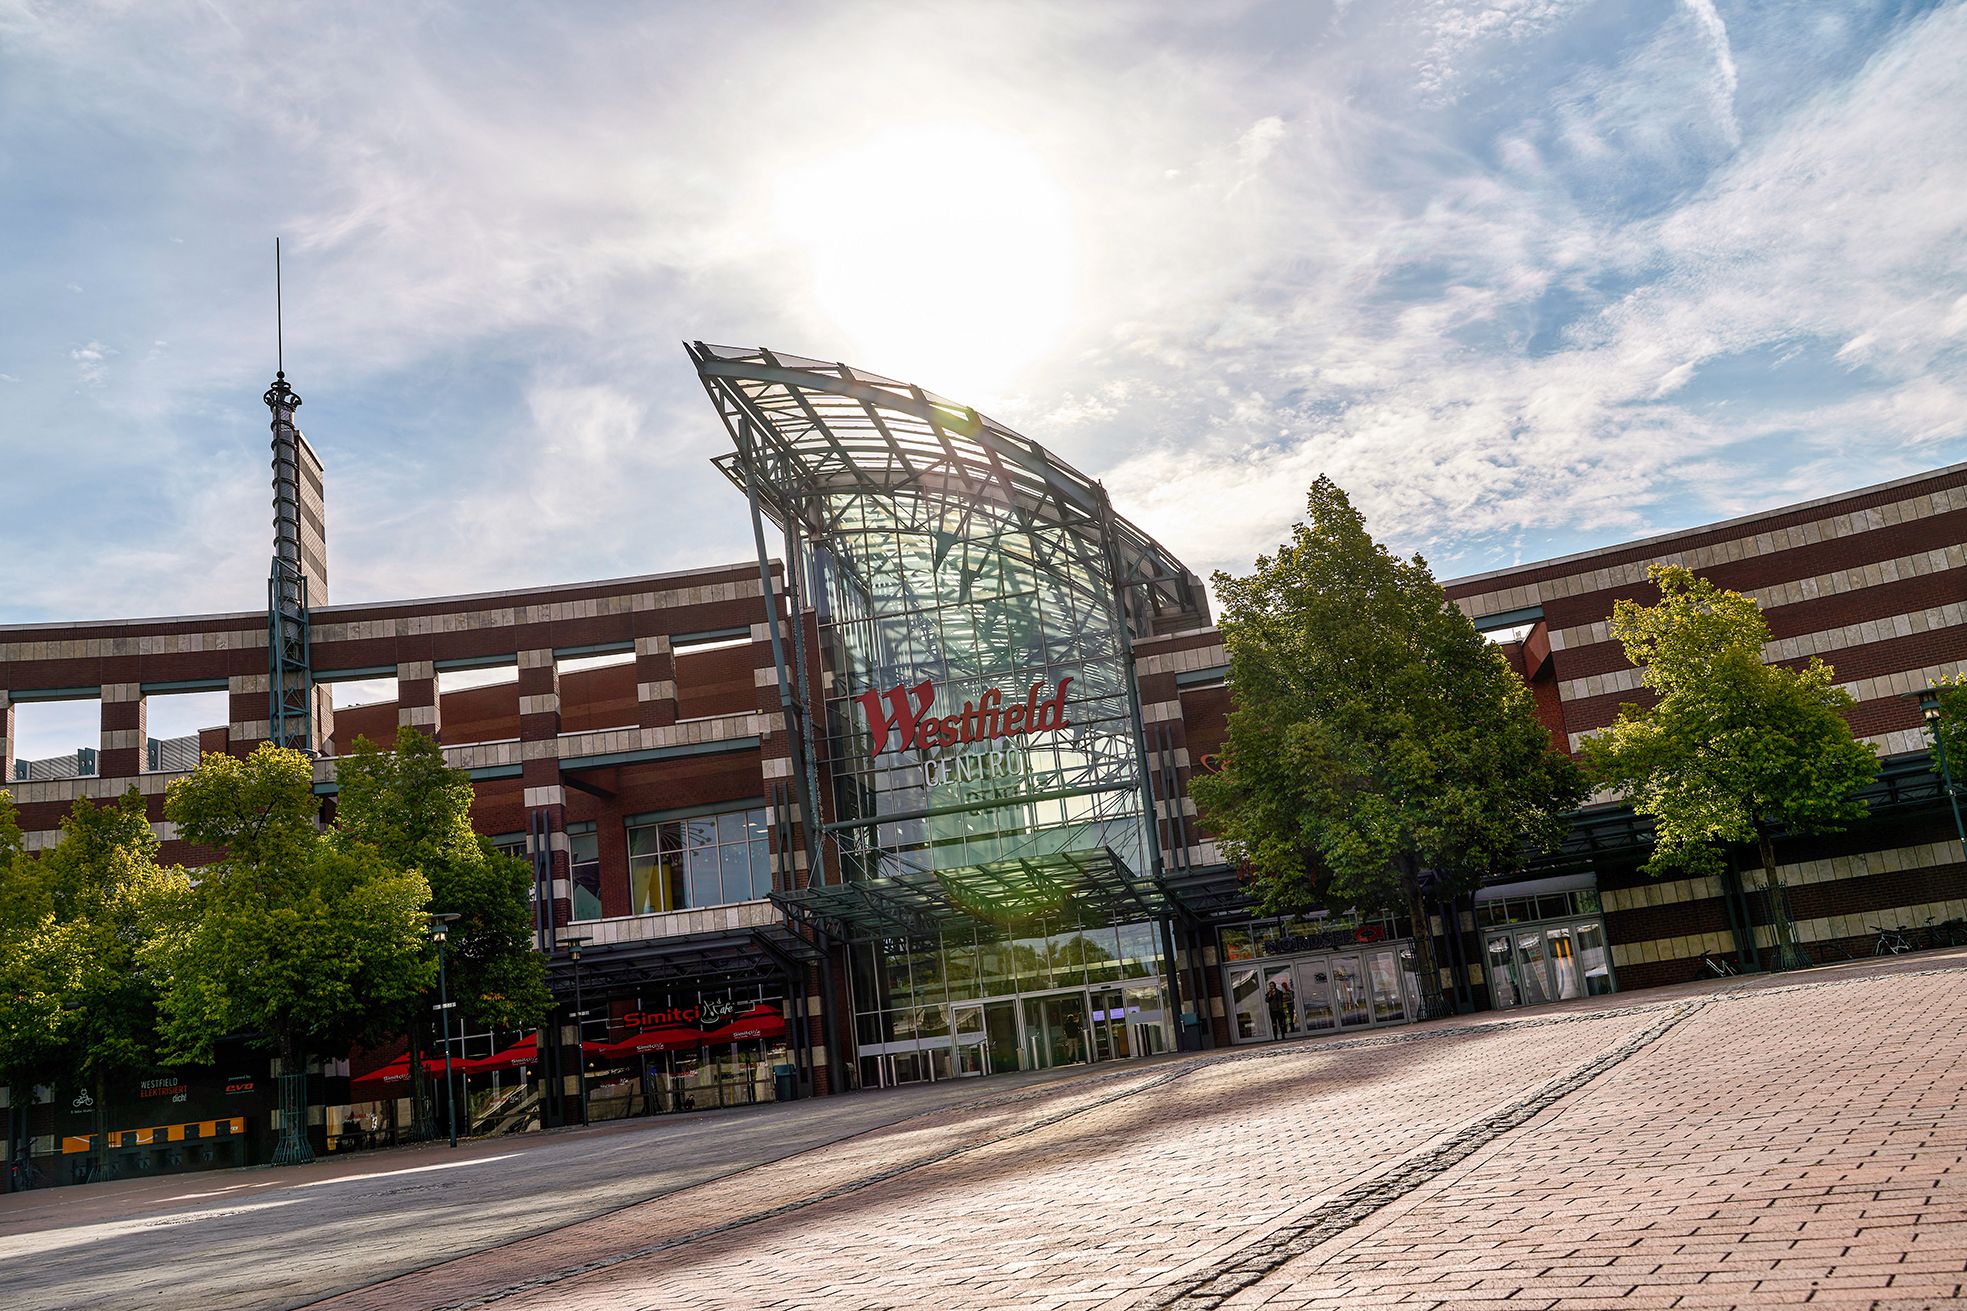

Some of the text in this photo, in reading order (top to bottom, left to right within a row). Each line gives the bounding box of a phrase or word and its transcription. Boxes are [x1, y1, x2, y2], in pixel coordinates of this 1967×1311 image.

[855, 676, 1075, 759] Westfield
[924, 749, 1022, 787] CENTRO
[1264, 931, 1353, 953] NORDSEE
[623, 1005, 700, 1028] Simitçi
[140, 1077, 178, 1089] WESTFIELD
[140, 1085, 188, 1098] ELEKTRISIERT
